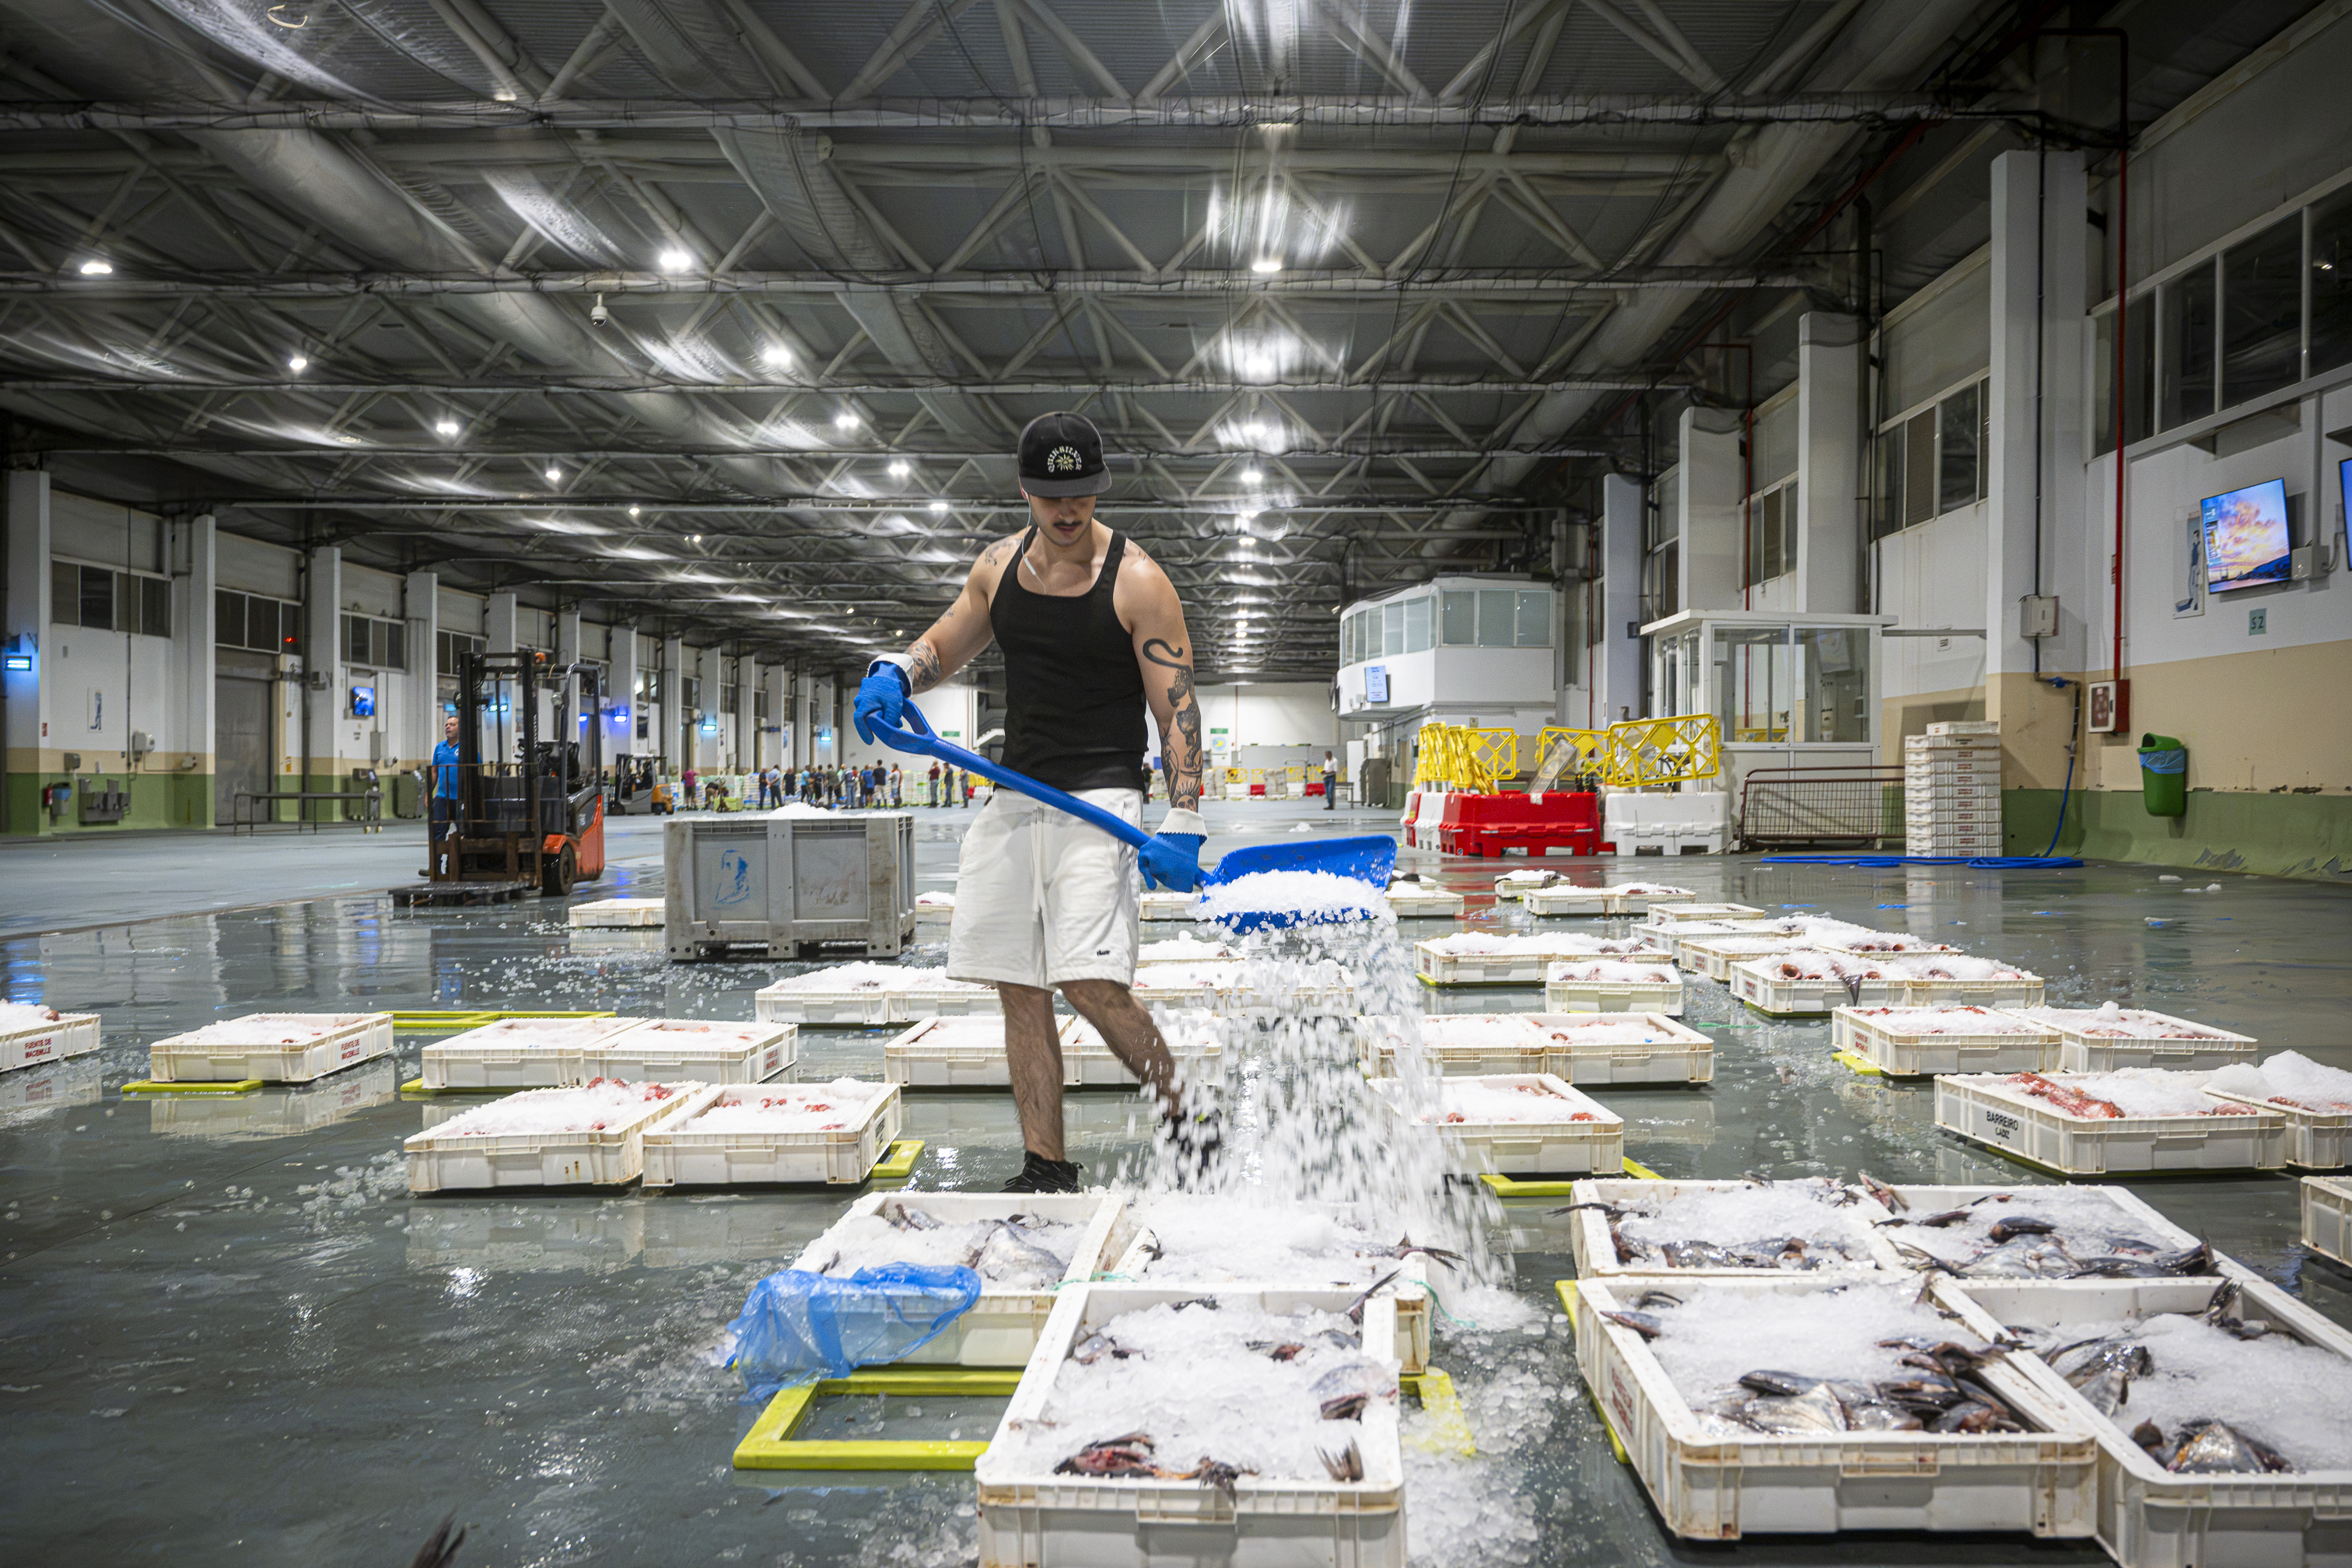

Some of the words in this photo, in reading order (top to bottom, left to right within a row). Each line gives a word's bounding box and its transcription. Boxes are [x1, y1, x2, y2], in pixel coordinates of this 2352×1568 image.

[1047, 446, 1082, 473] QUIKSILVER
[44, 1037, 52, 1046] DE
[1986, 1110, 2019, 1131] BARREIRO
